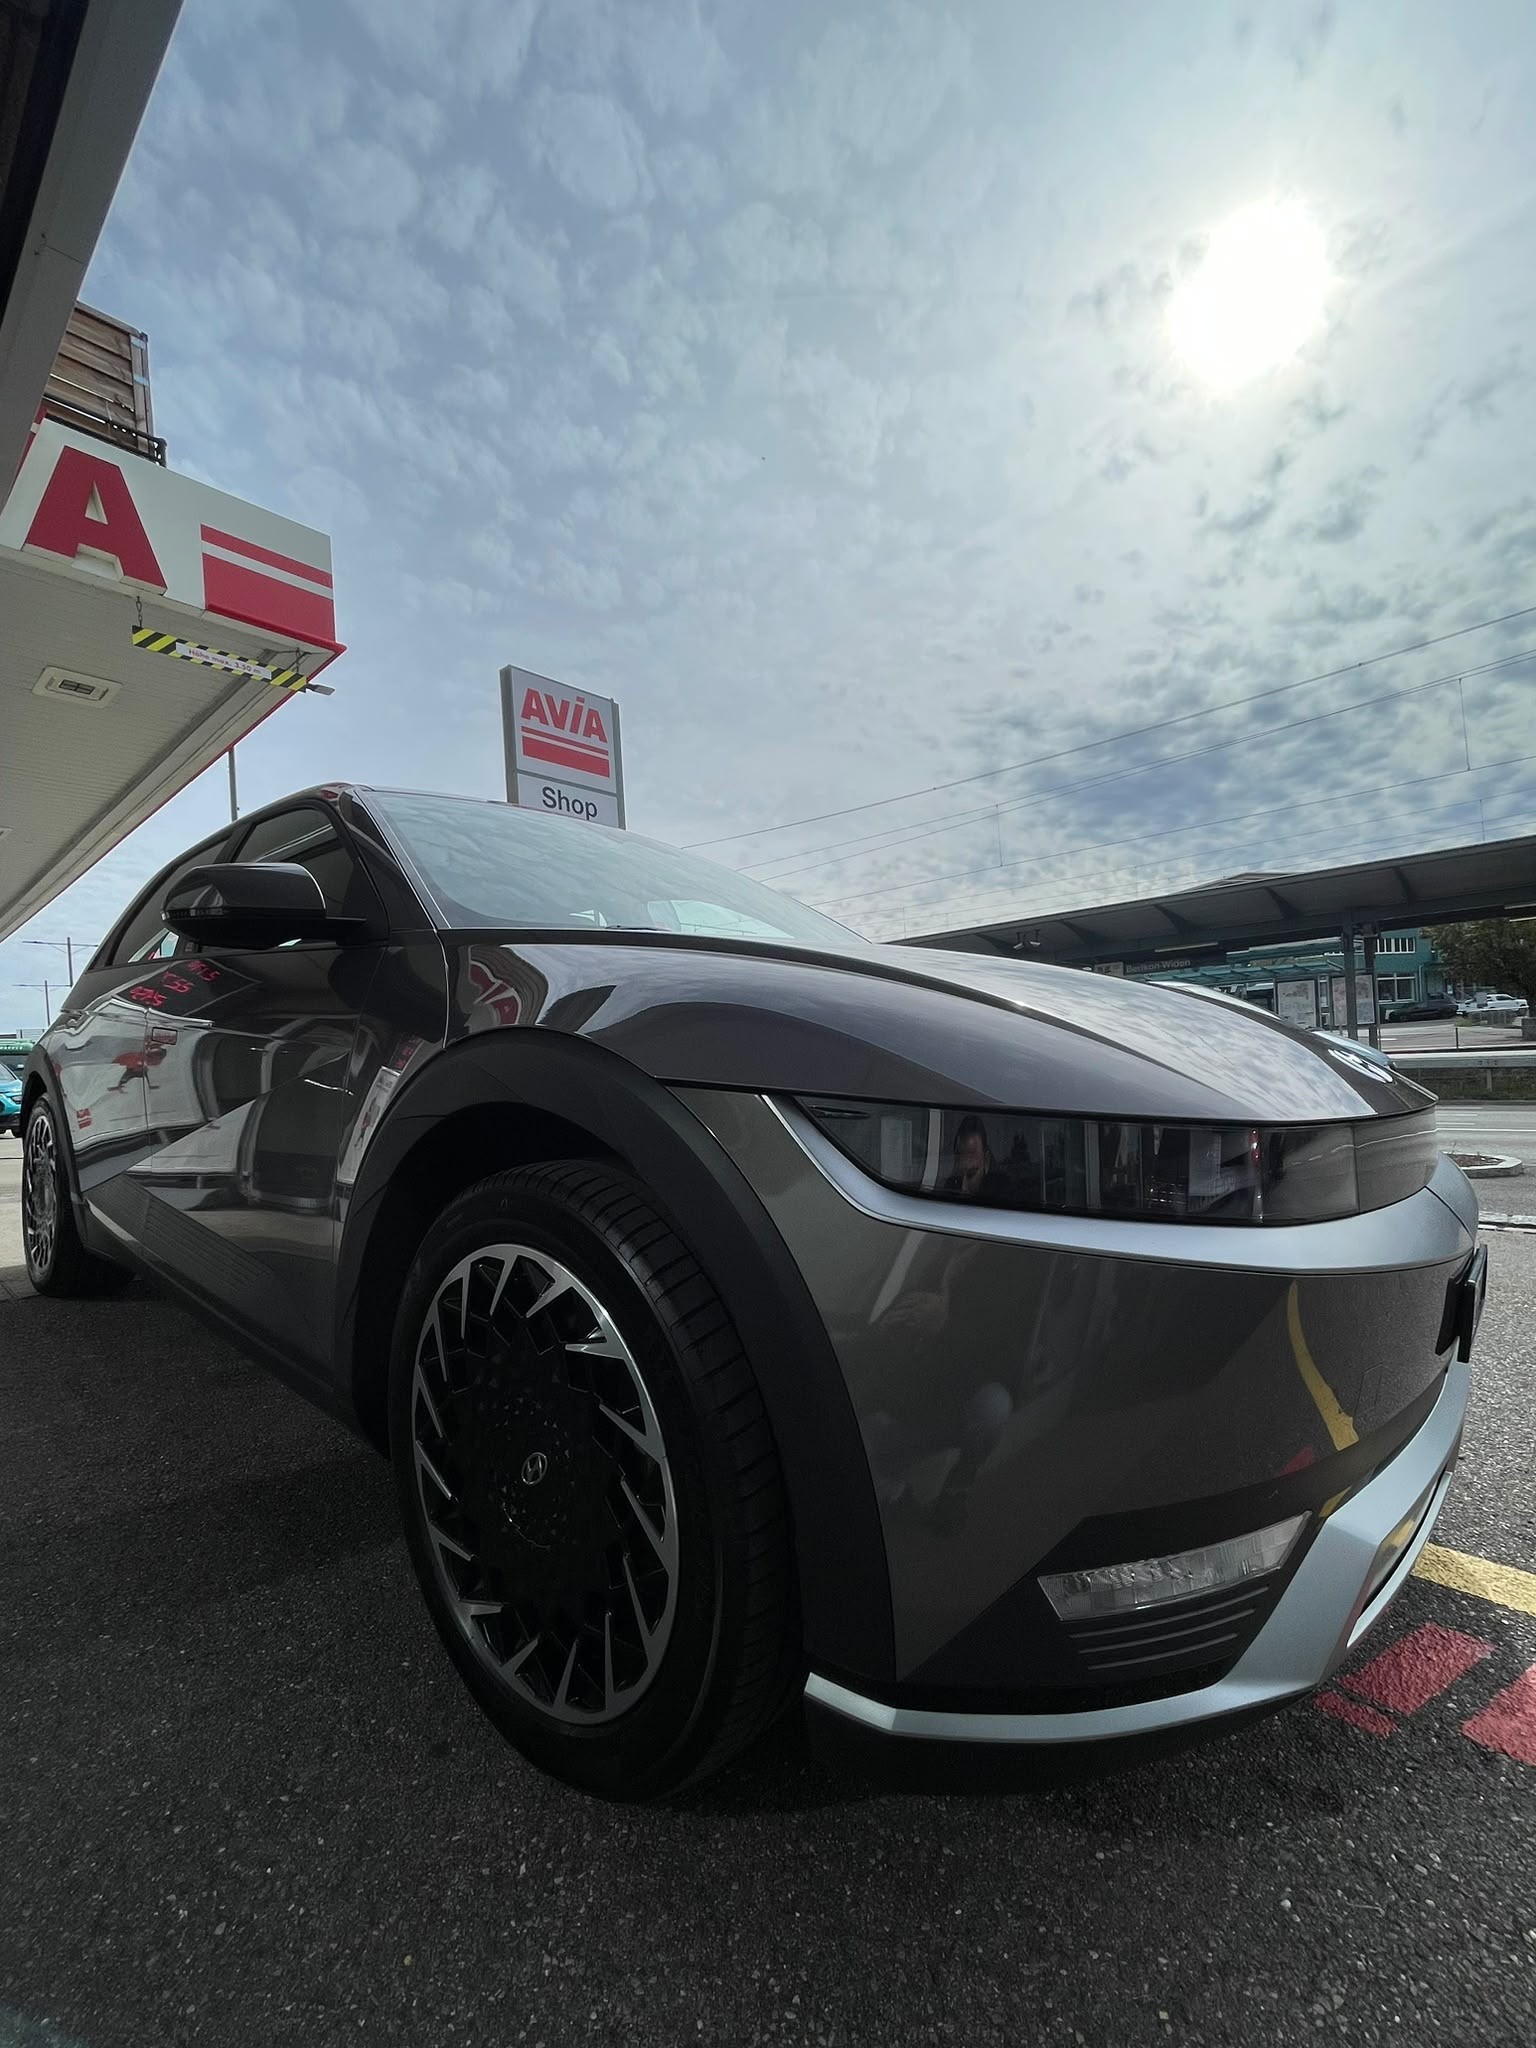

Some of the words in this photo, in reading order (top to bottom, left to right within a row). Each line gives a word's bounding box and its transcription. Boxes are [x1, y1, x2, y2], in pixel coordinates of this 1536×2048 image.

[21, 445, 168, 595] A
[188, 648, 210, 660] Höhe
[541, 786, 598, 821] Shop
